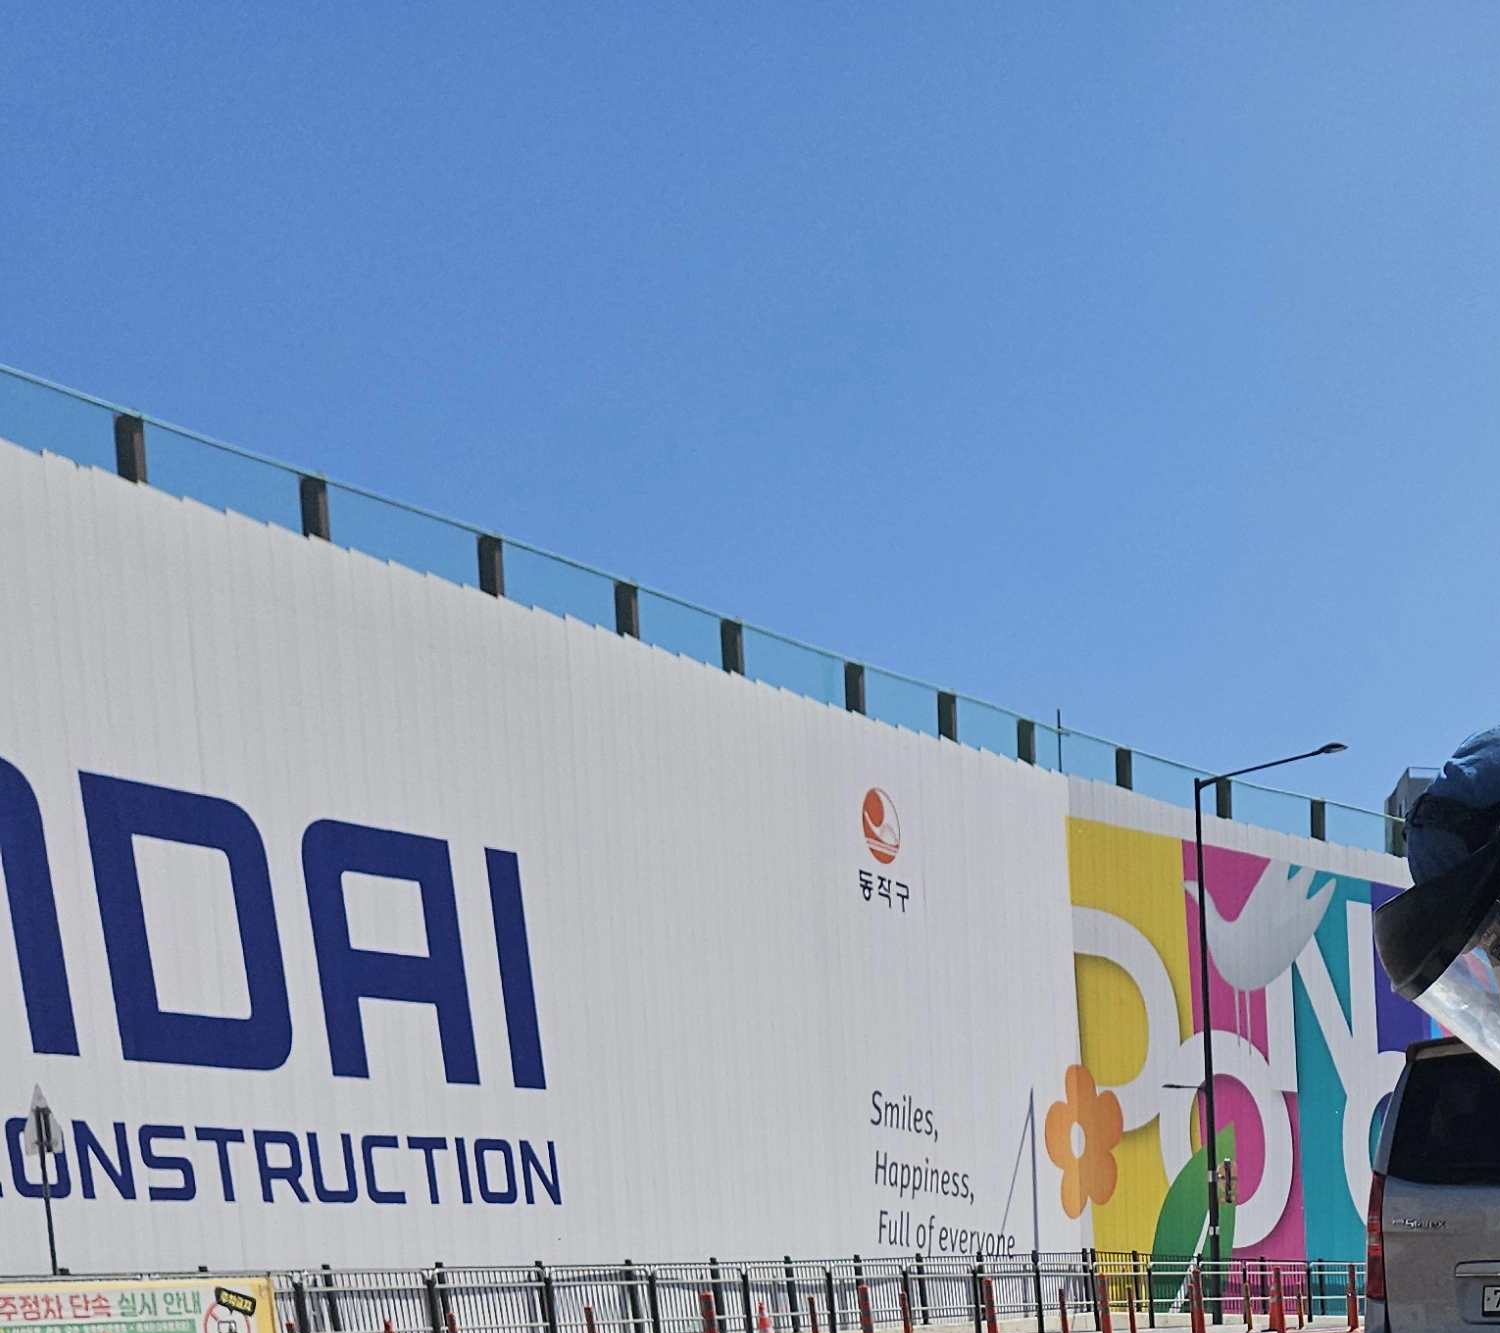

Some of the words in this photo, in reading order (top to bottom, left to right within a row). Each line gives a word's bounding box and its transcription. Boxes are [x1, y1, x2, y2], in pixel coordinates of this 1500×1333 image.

[859, 869, 909, 912] 동작구
[870, 1089, 938, 1143] Smiles,
[0, 1117, 562, 1205] ONSTRUCTION
[875, 1150, 974, 1205] Happiness,
[878, 1210, 910, 1248] Full
[916, 1215, 936, 1257] of
[938, 1225, 1016, 1259] everyone
[69, 1291, 111, 1319] 단속
[118, 1290, 157, 1317] 실시
[163, 1289, 202, 1316] 안내
